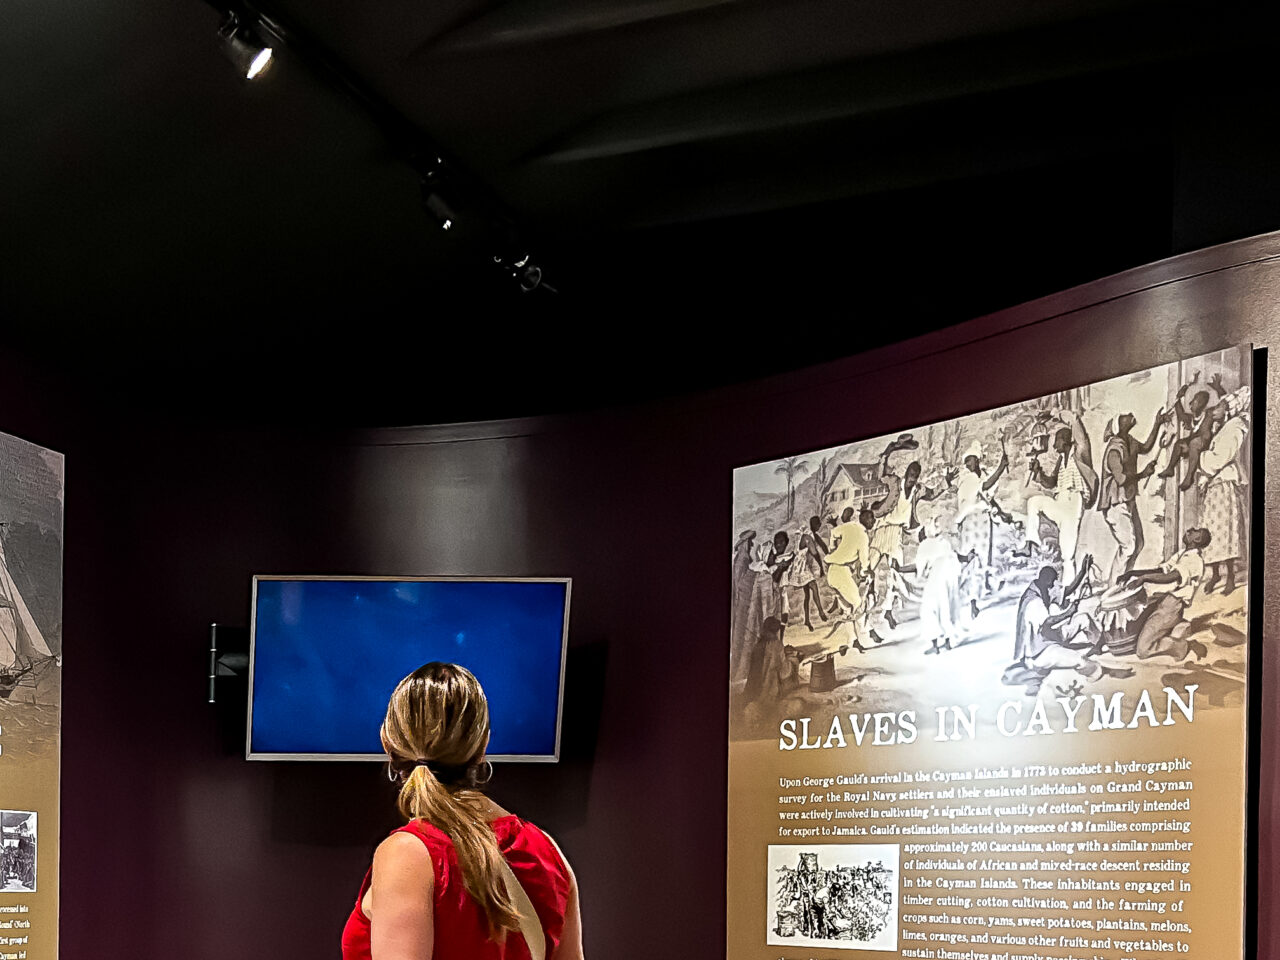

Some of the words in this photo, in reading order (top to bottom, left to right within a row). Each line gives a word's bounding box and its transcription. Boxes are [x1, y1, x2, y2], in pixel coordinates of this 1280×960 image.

[779, 710, 917, 751] SLAVES
[934, 704, 978, 743] IN
[996, 684, 1199, 738] CAYMAN
[904, 877, 912, 887] in
[917, 877, 932, 887] the
[936, 878, 976, 890] Cayman
[980, 878, 1018, 888] Islands.
[1022, 878, 1053, 889] These
[1058, 878, 1120, 890] inhabitants
[1125, 880, 1176, 893] engaged
[1180, 880, 1190, 891] in
